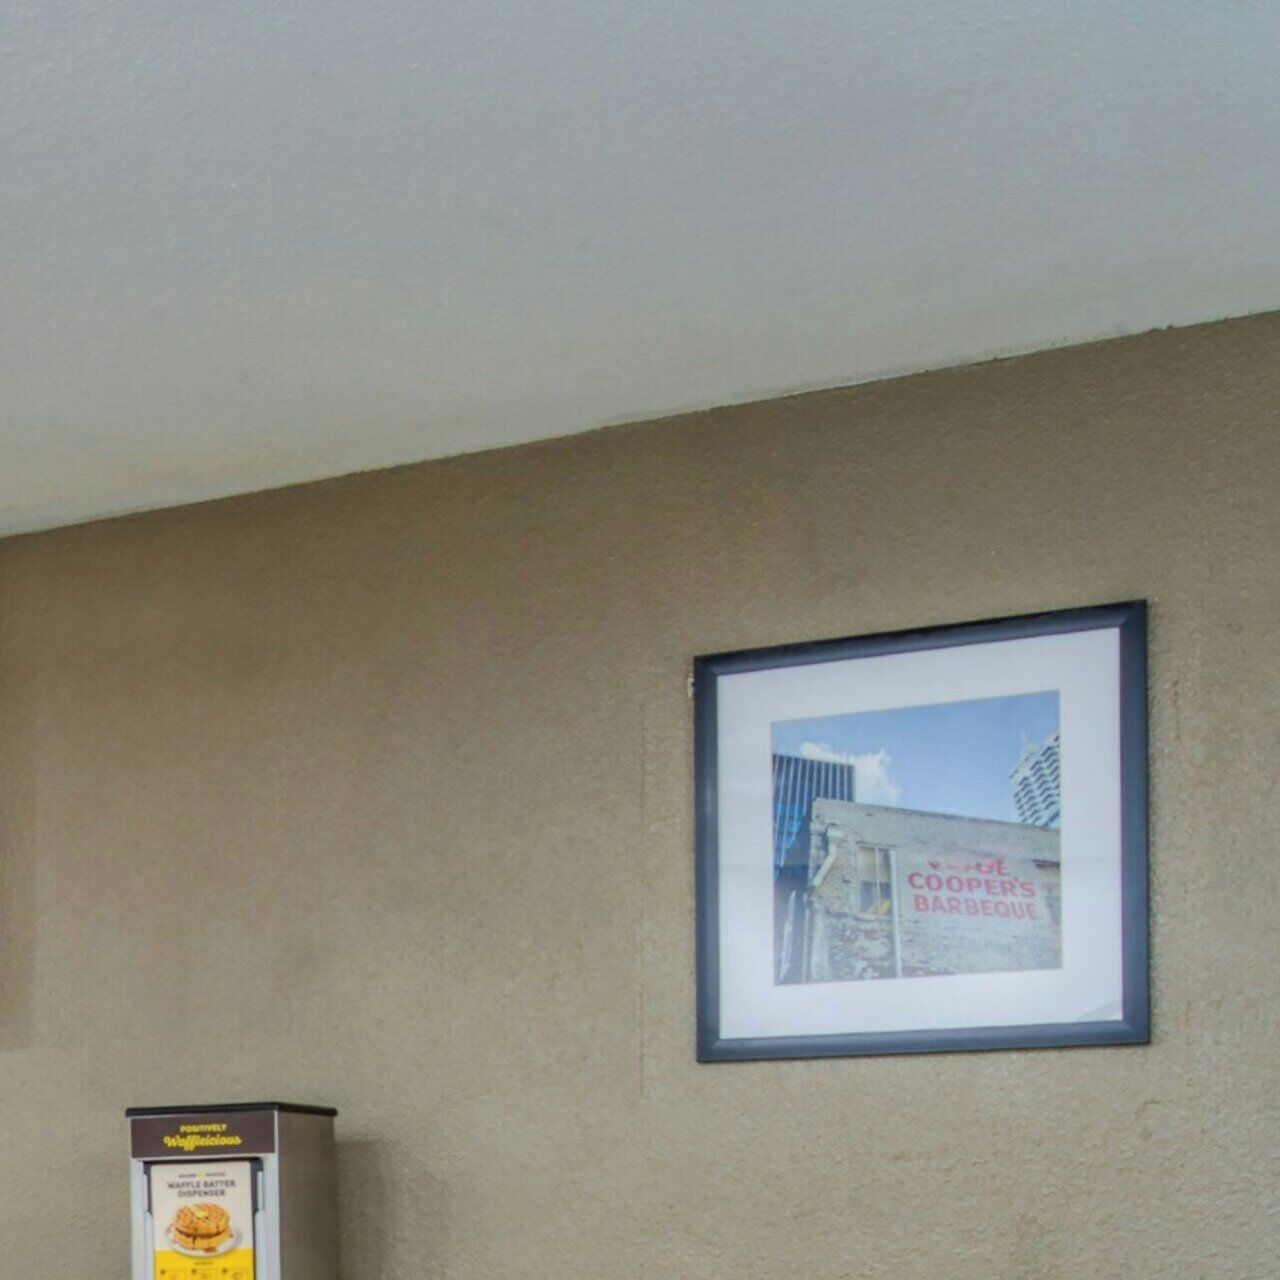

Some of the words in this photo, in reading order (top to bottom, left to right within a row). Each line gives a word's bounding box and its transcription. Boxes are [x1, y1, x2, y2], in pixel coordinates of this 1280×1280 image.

[907, 871, 1036, 898] COOPER'S
[913, 893, 1038, 919] BARBEQUE
[167, 1181, 200, 1189] WAFFLE
[203, 1180, 236, 1188] BATTER
[177, 1189, 225, 1198] DISPENSER
